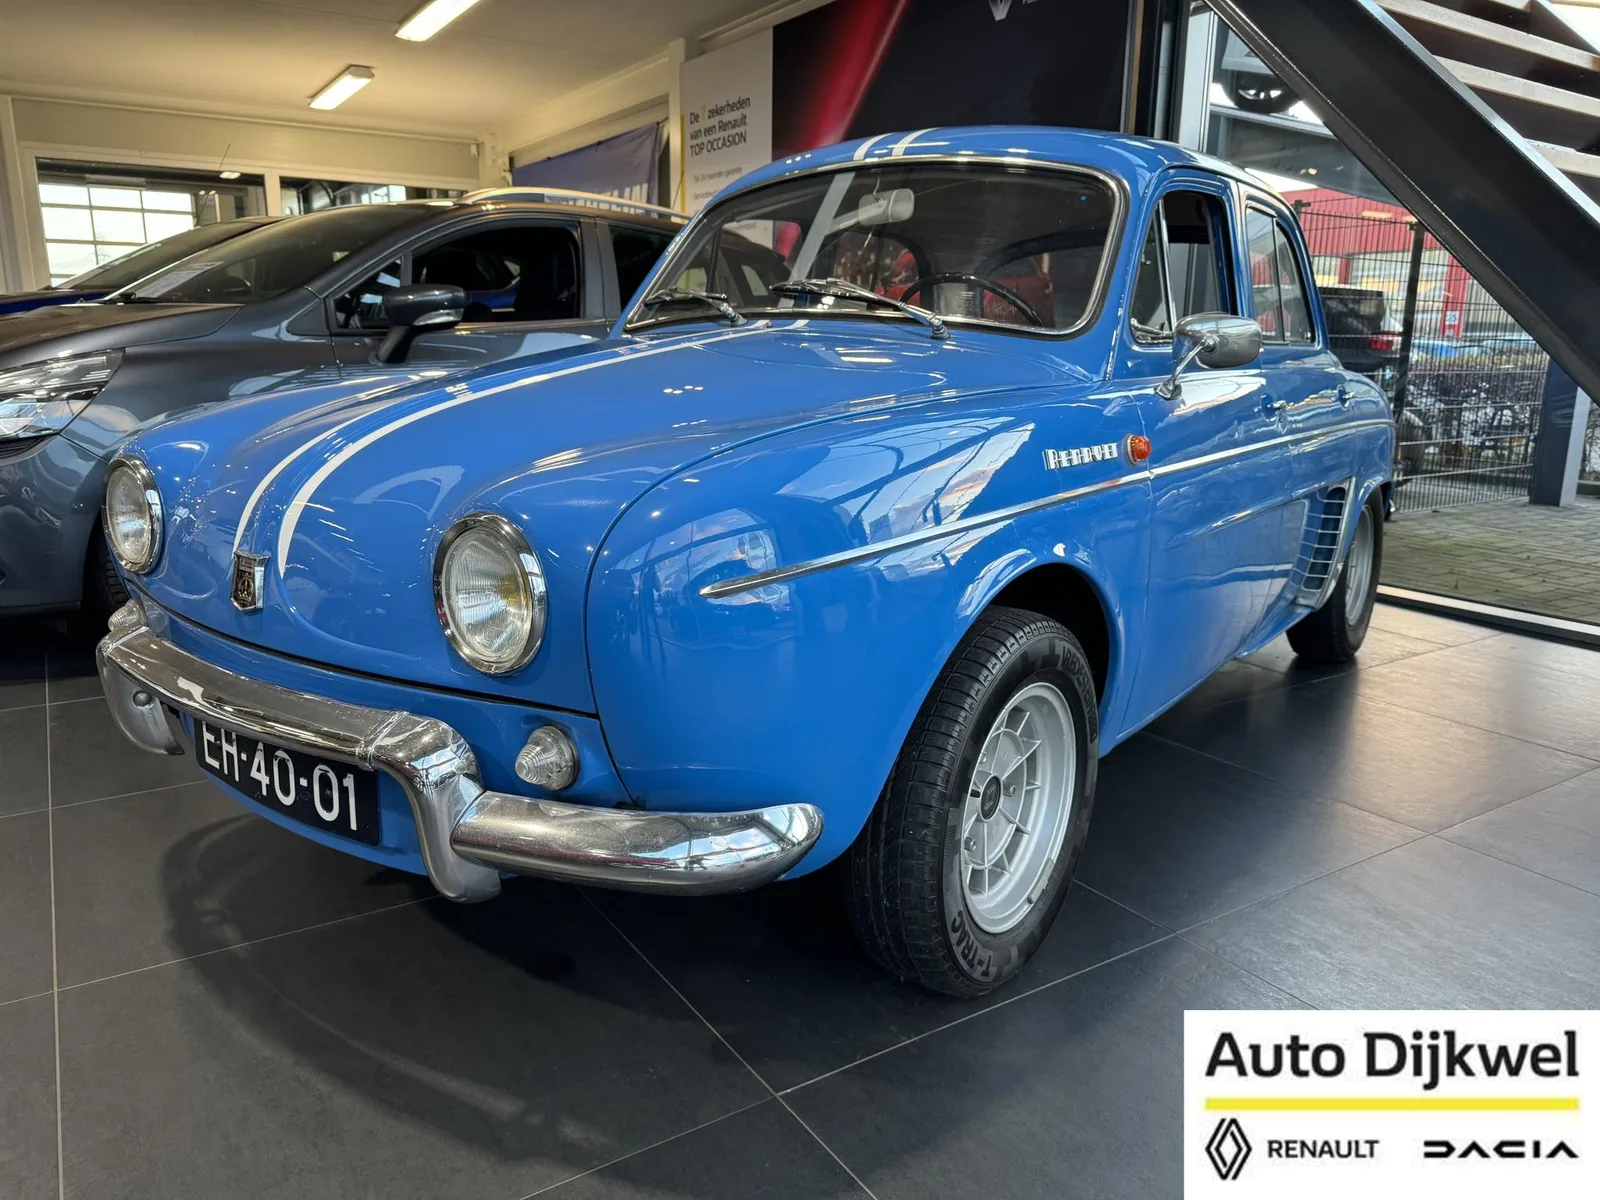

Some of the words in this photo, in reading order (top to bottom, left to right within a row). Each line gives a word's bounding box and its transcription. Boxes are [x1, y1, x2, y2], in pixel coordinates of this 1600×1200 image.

[689, 112, 700, 125] De
[707, 96, 751, 120] zekerheden
[689, 128, 702, 140] van
[703, 125, 717, 138] een
[718, 113, 747, 134] Renault
[689, 142, 705, 156] TOP
[706, 131, 747, 153] OCCASION
[202, 720, 358, 832] EH-40-01
[951, 910, 992, 978] T-TRAC
